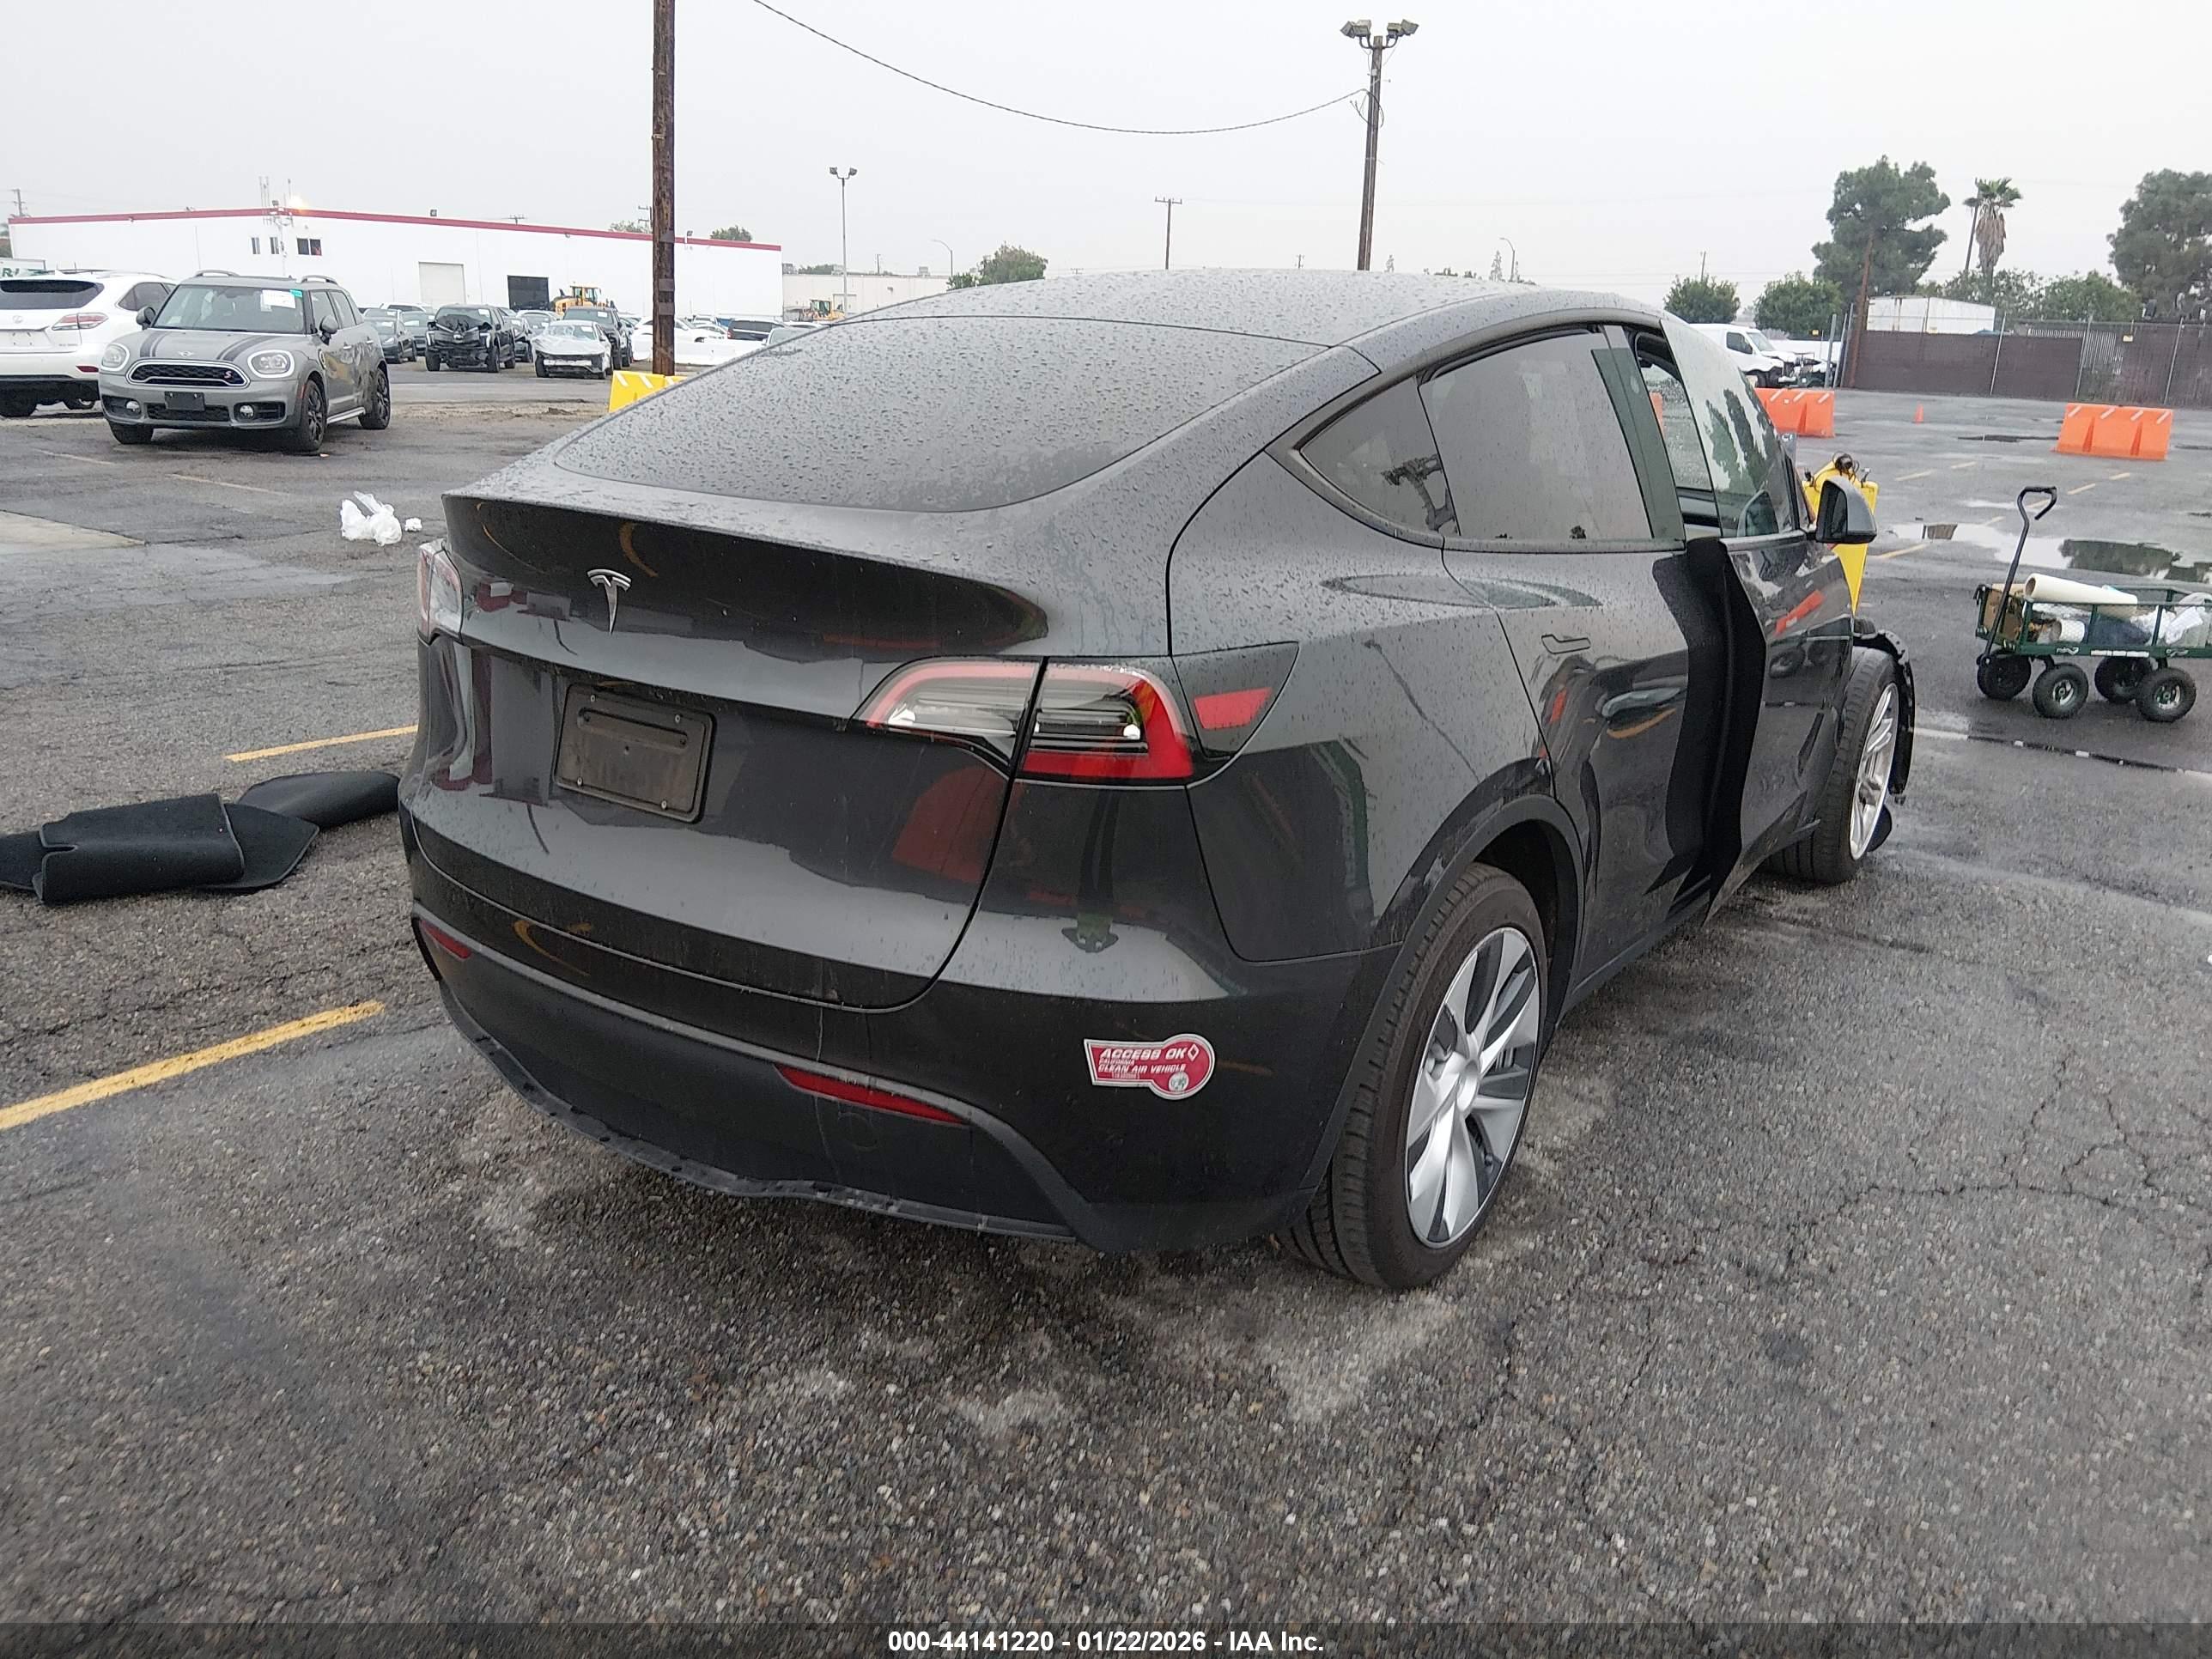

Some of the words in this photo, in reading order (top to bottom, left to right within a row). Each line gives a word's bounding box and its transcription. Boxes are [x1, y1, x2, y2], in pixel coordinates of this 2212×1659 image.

[1100, 1048, 1162, 1060] ACCESS
[1165, 1048, 1188, 1060] OK
[1098, 1064, 1130, 1073] CLEAN
[1132, 1065, 1148, 1073] AIR
[1151, 1064, 1187, 1073] VEHICLE
